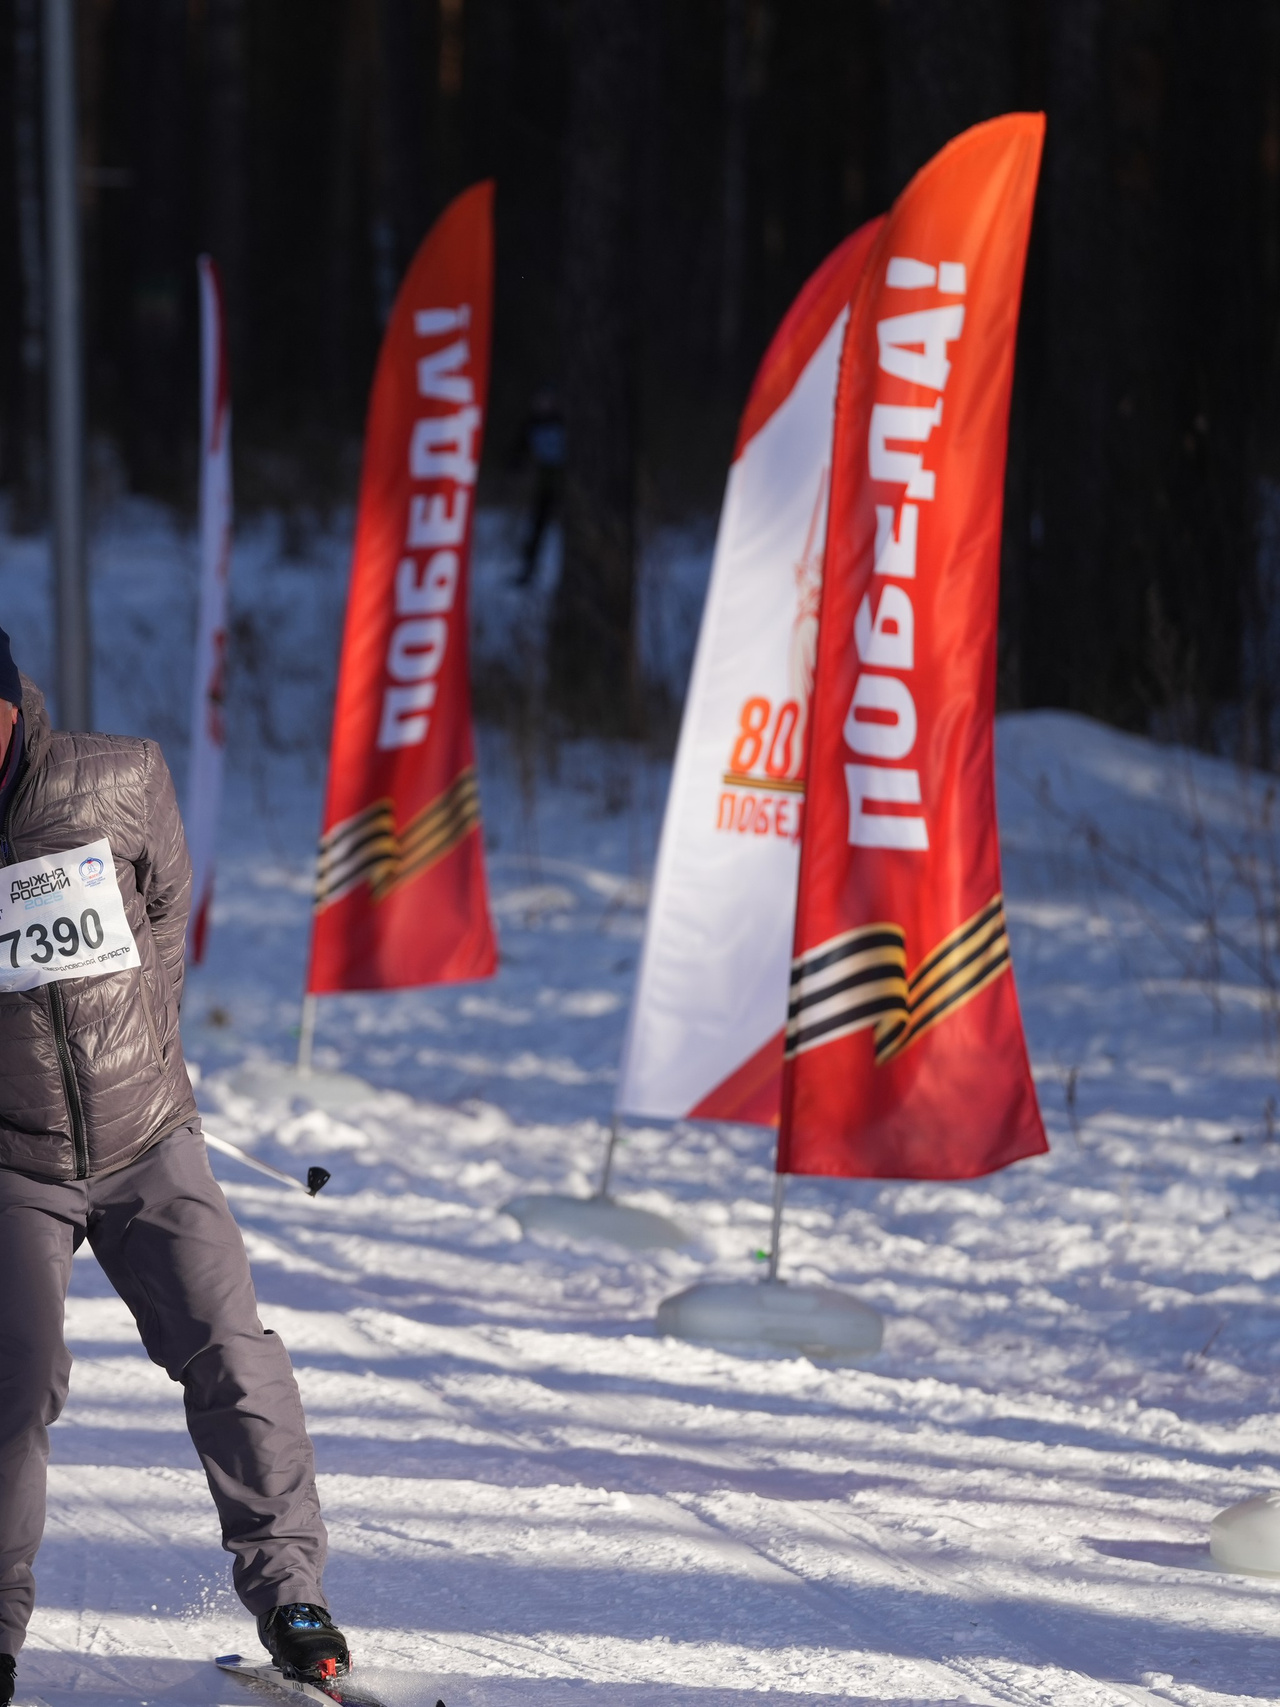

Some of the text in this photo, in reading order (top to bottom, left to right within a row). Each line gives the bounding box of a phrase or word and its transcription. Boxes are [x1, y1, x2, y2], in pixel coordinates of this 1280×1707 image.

[842, 256, 966, 851] ПОБЕДА!
[729, 696, 800, 778] 80
[10, 877, 71, 904] РОССИИ
[11, 867, 66, 892] ЛЫЖНЯ
[24, 891, 64, 911] 2025
[97, 946, 131, 963] ОБЛАСТЬ
